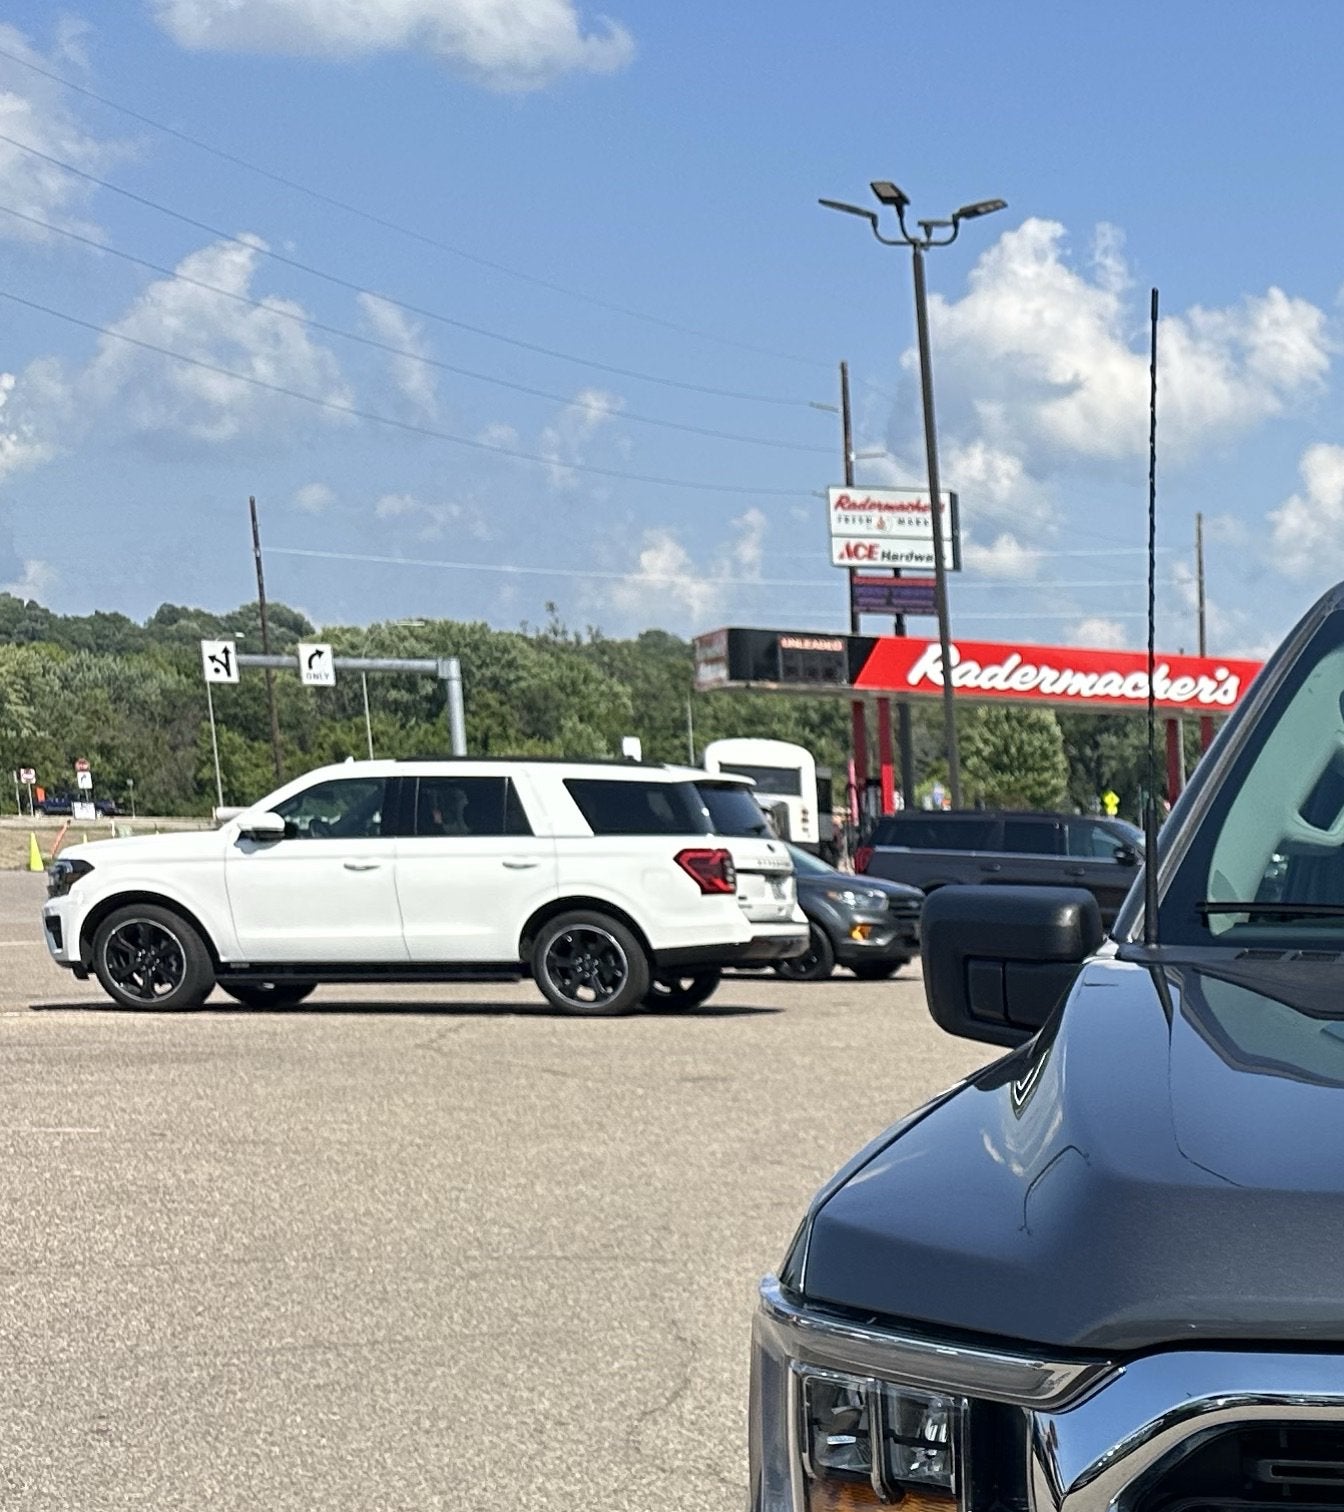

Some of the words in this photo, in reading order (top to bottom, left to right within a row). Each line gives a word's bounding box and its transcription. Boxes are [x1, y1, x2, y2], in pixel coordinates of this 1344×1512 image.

[839, 541, 879, 561] ACE
[881, 550, 945, 563] Hardwa
[907, 642, 1241, 705] Radermacher's
